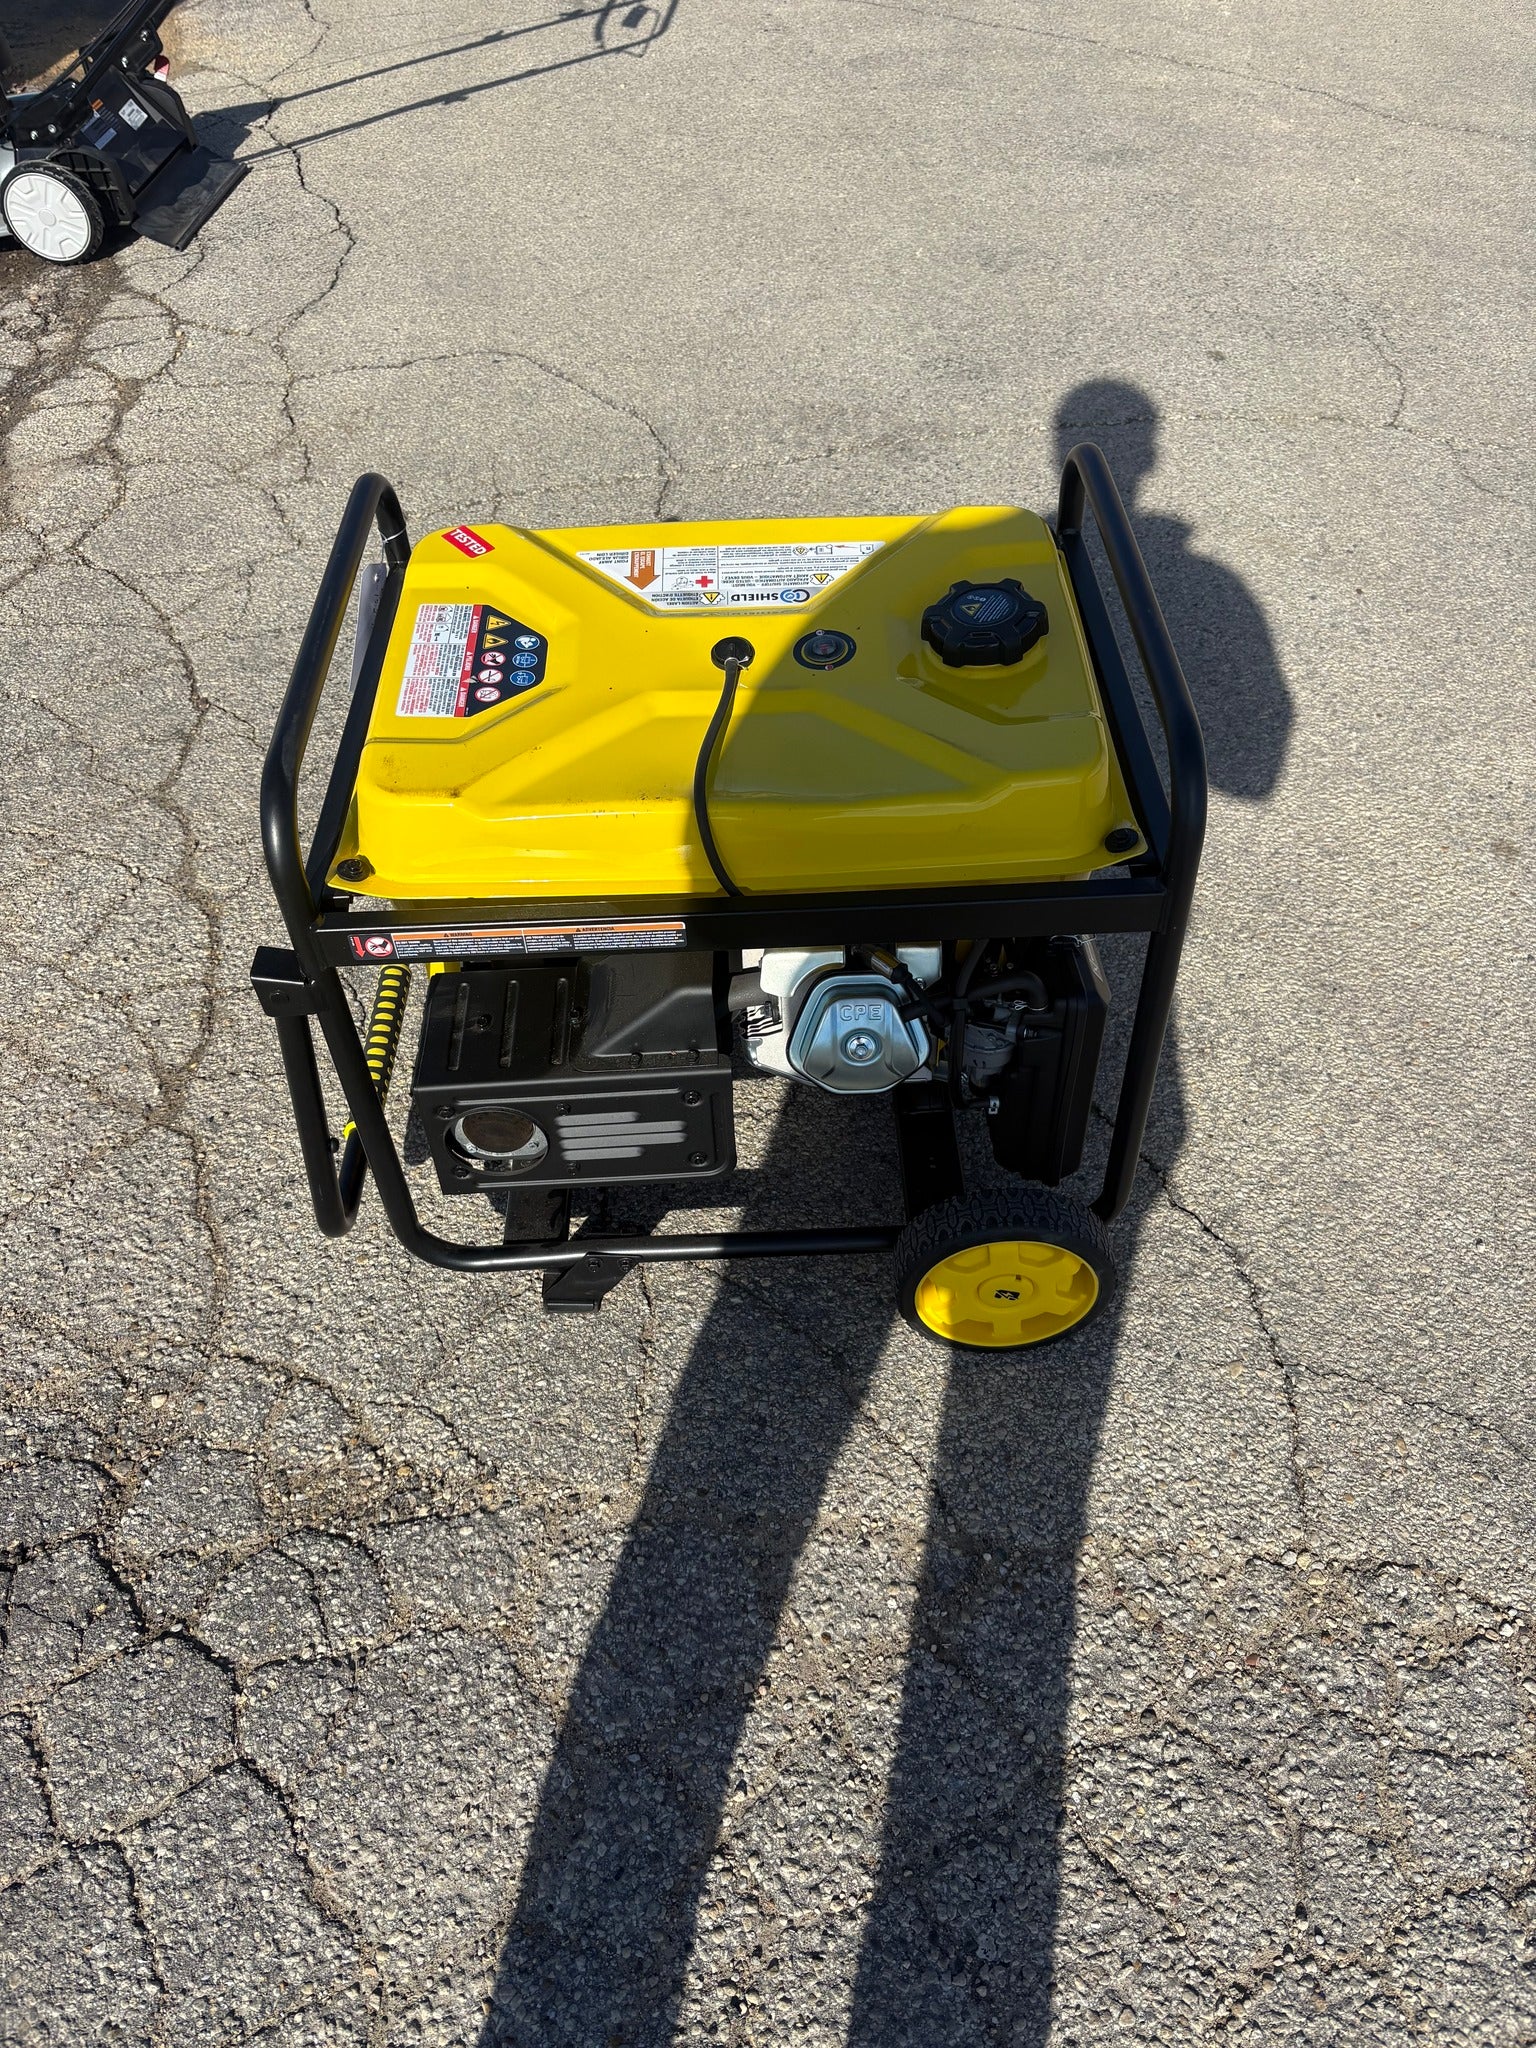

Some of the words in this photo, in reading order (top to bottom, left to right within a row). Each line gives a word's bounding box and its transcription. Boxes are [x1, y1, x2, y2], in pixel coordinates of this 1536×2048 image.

[450, 528, 487, 555] TESTED
[731, 592, 779, 602] SHIELD
[471, 619, 479, 634] DANGER
[464, 655, 473, 671] PELIGRO
[458, 692, 467, 708] DANGER
[840, 1004, 882, 1021] CPE
